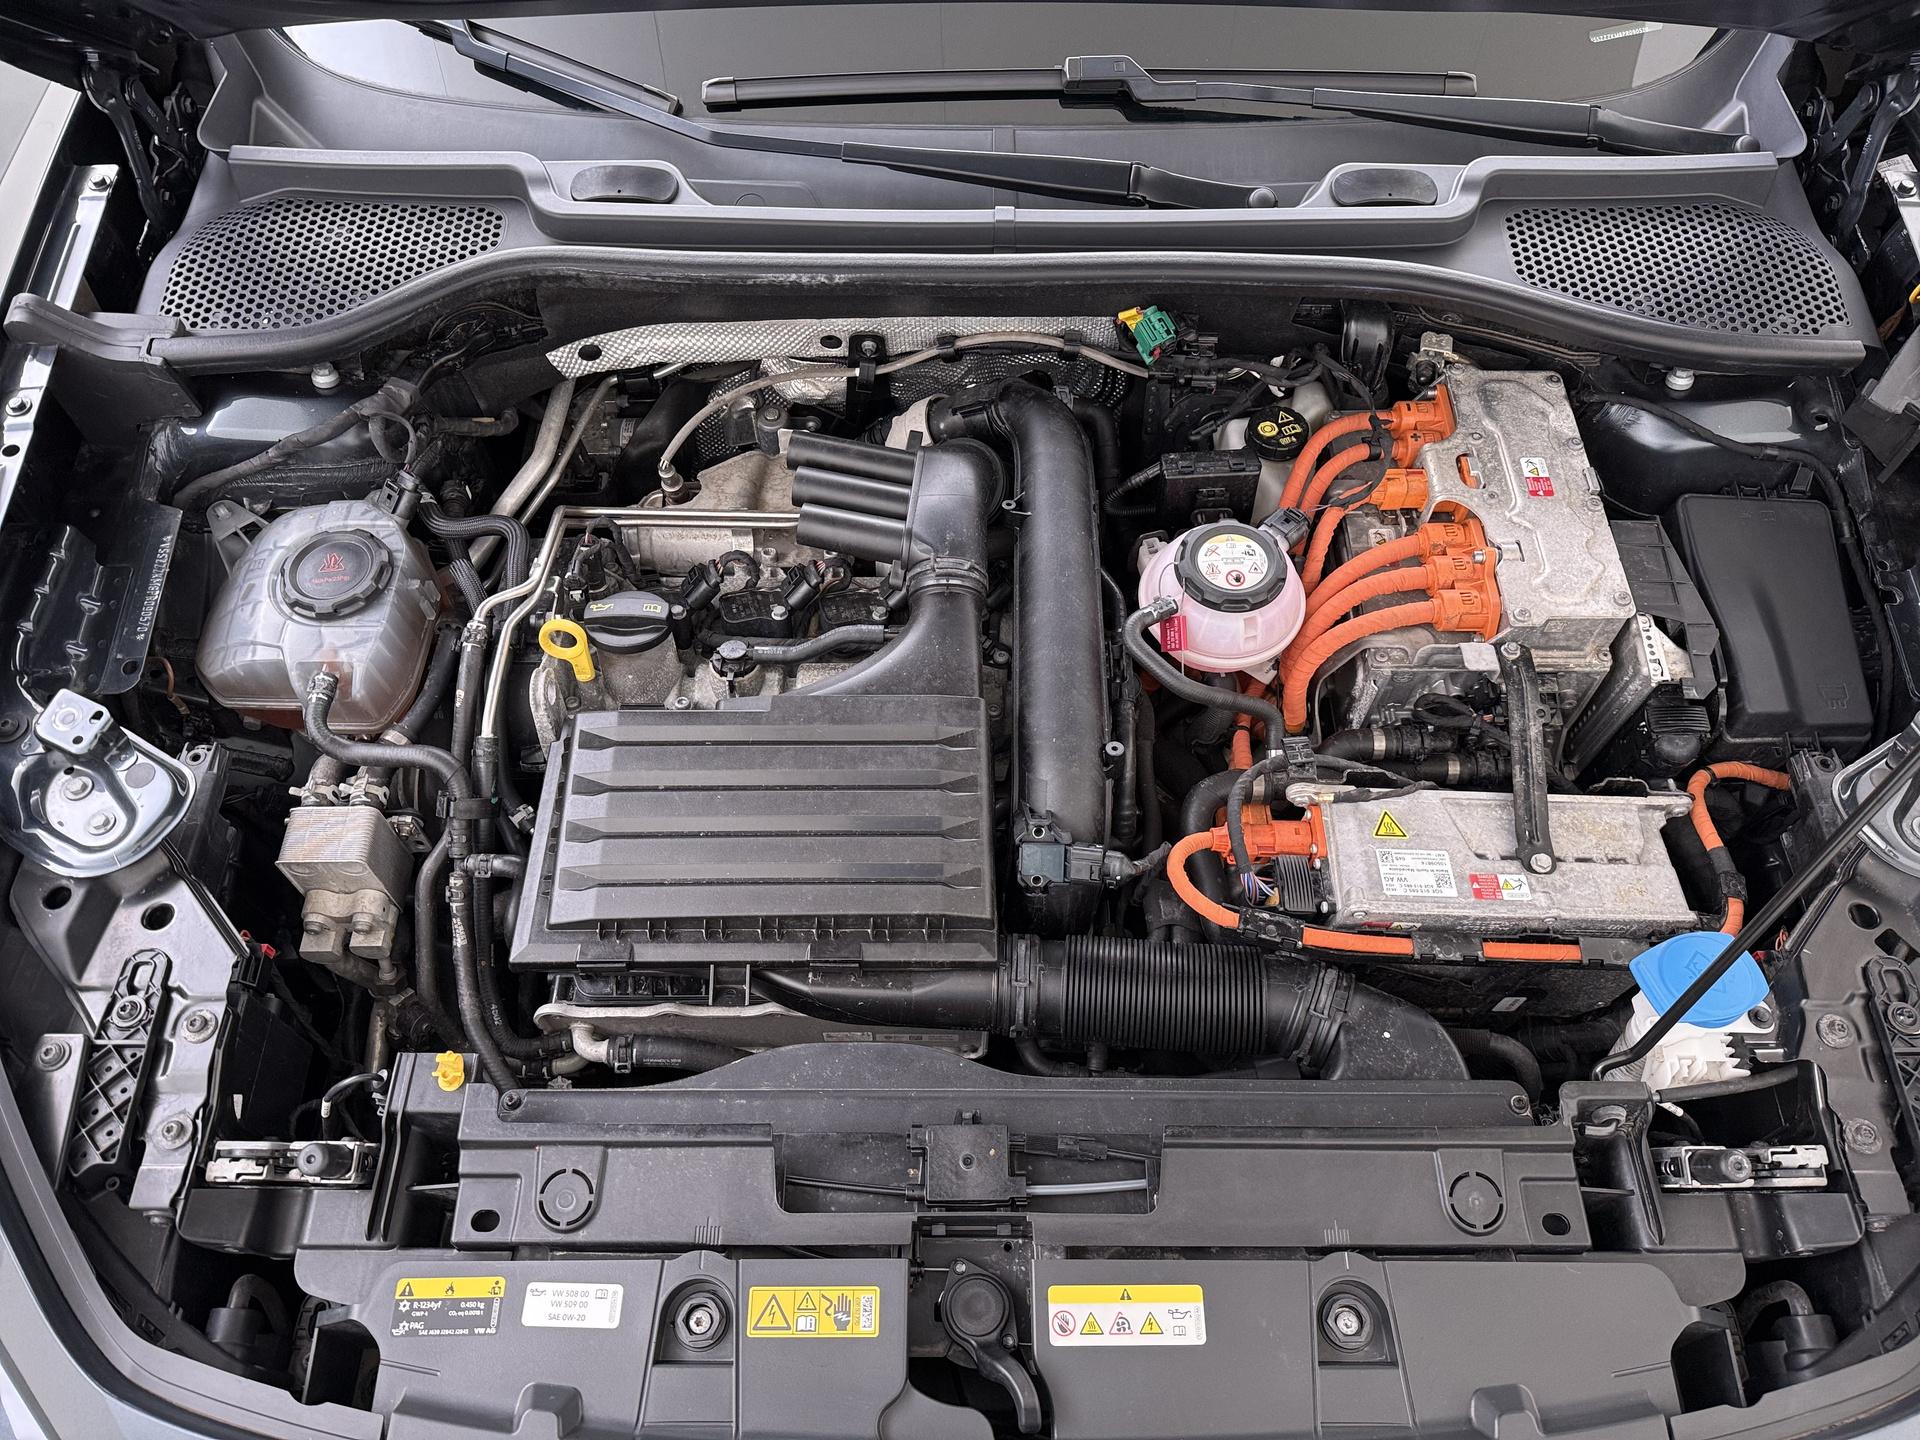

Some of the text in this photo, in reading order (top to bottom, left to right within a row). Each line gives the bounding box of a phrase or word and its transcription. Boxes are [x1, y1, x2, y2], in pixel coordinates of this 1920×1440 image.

[551, 1289, 590, 1298] VW 508 00
[413, 1301, 442, 1311] R-1234yf
[477, 1301, 485, 1309] kg
[550, 1299, 589, 1308] VW 509 00
[547, 1313, 587, 1322] SAE 0W-20
[409, 1321, 425, 1330] PAG
